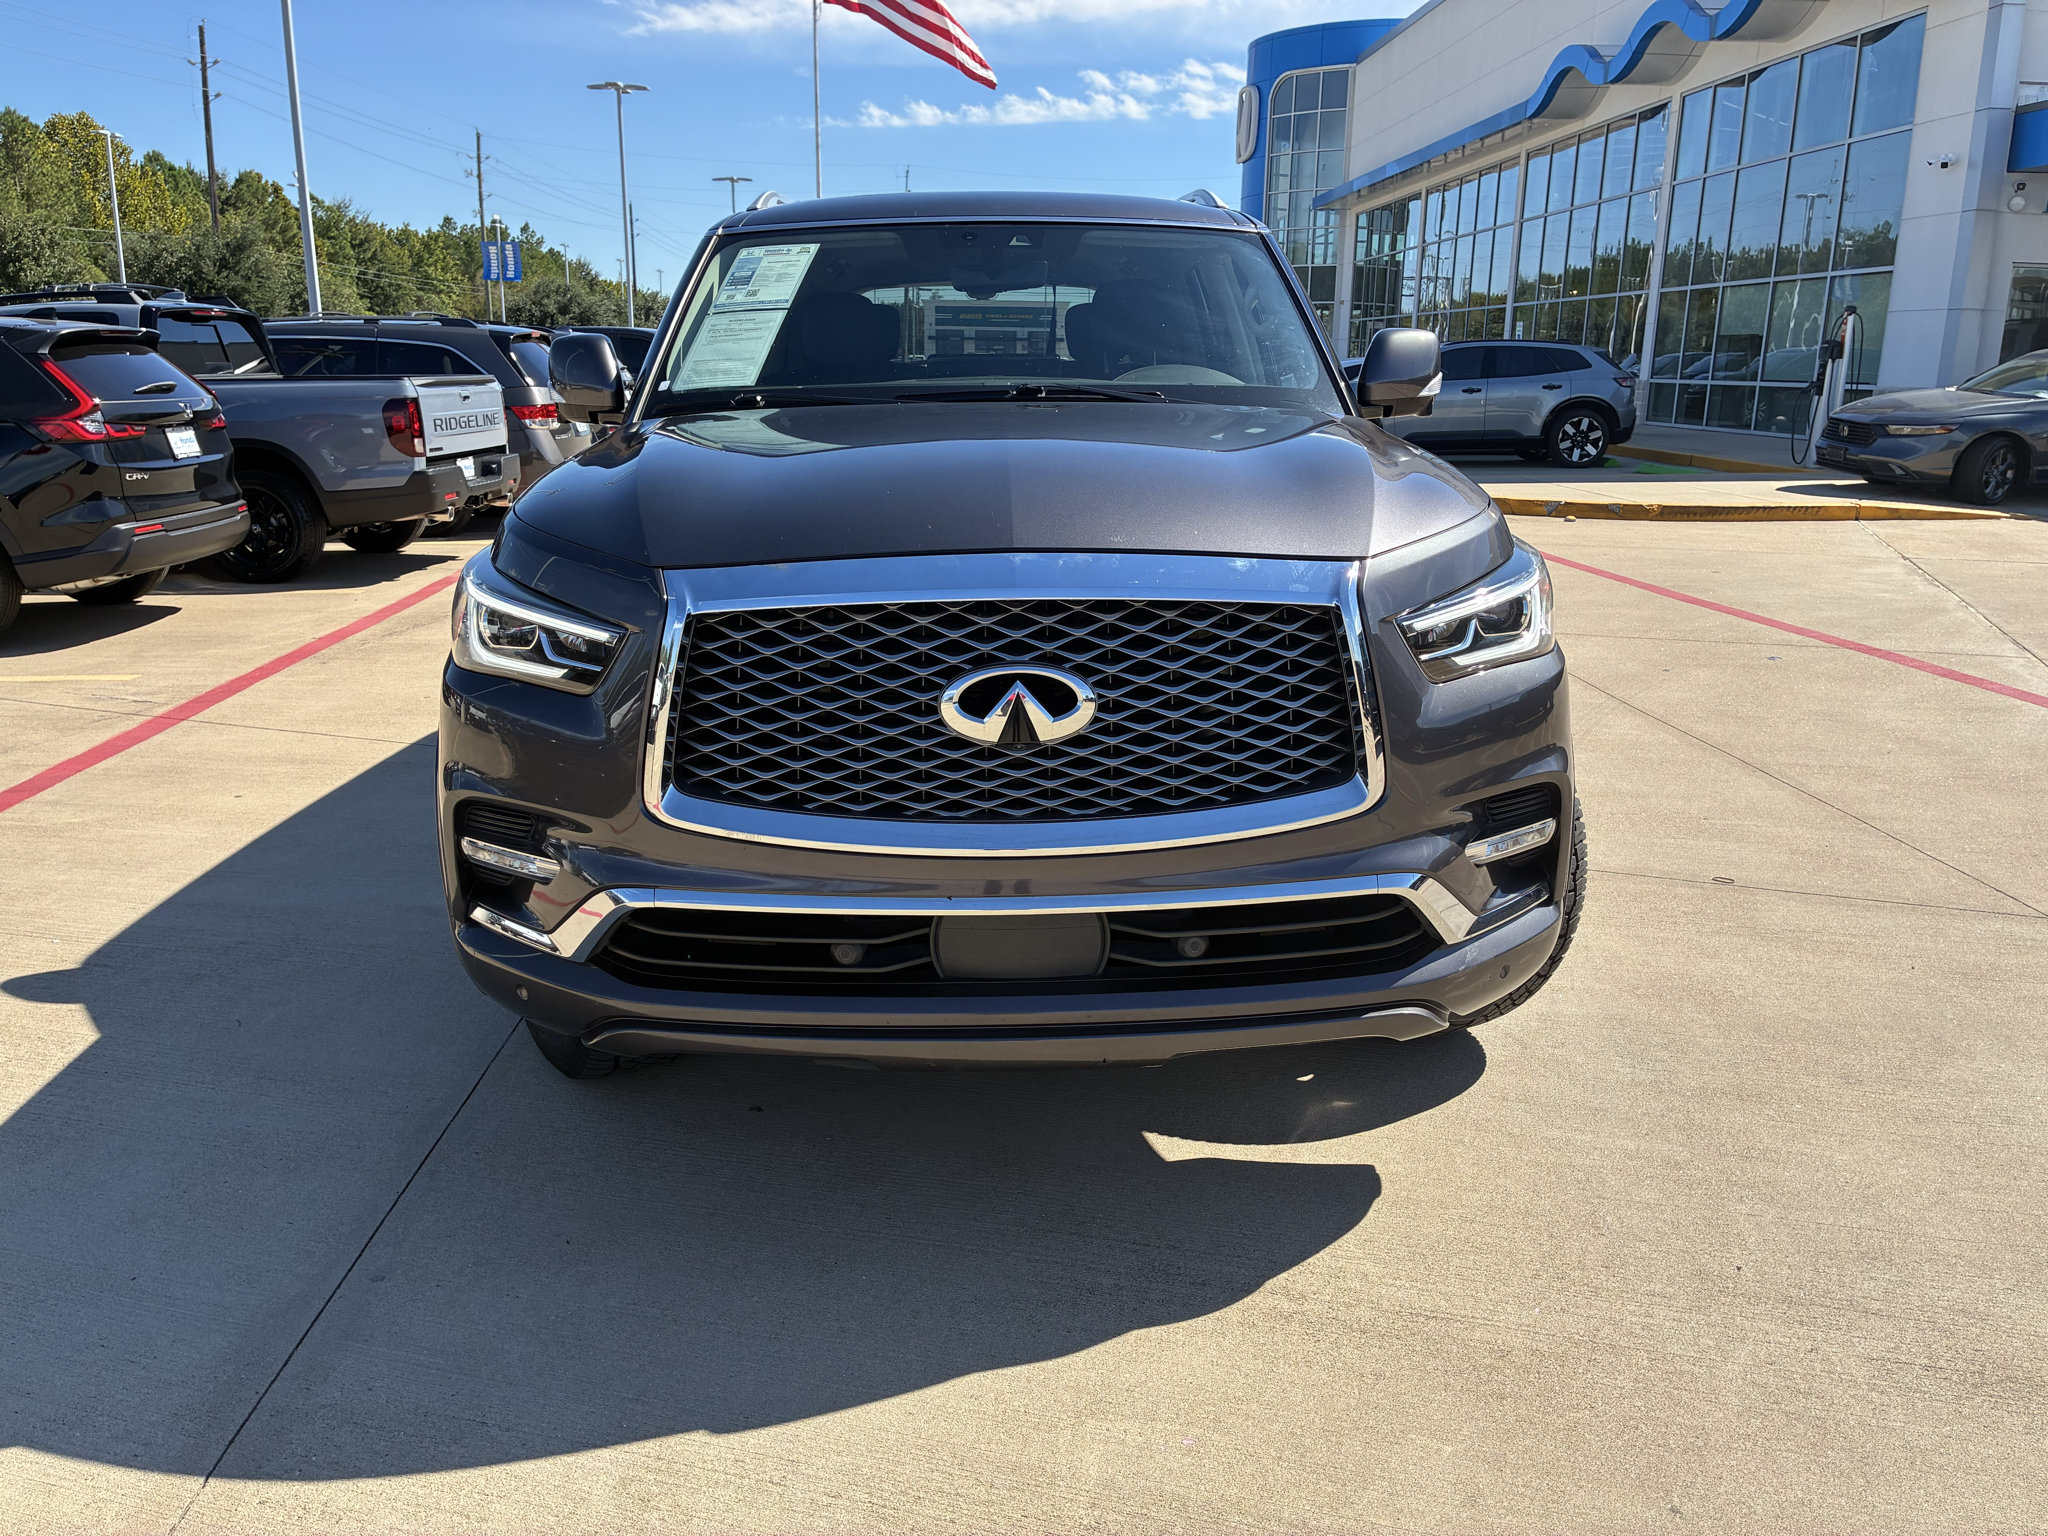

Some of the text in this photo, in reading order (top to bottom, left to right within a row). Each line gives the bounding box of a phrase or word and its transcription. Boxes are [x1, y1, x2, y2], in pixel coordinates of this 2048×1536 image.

[488, 246, 499, 279] Honda
[505, 244, 515, 278] Honda
[433, 412, 500, 432] RIDGELINE
